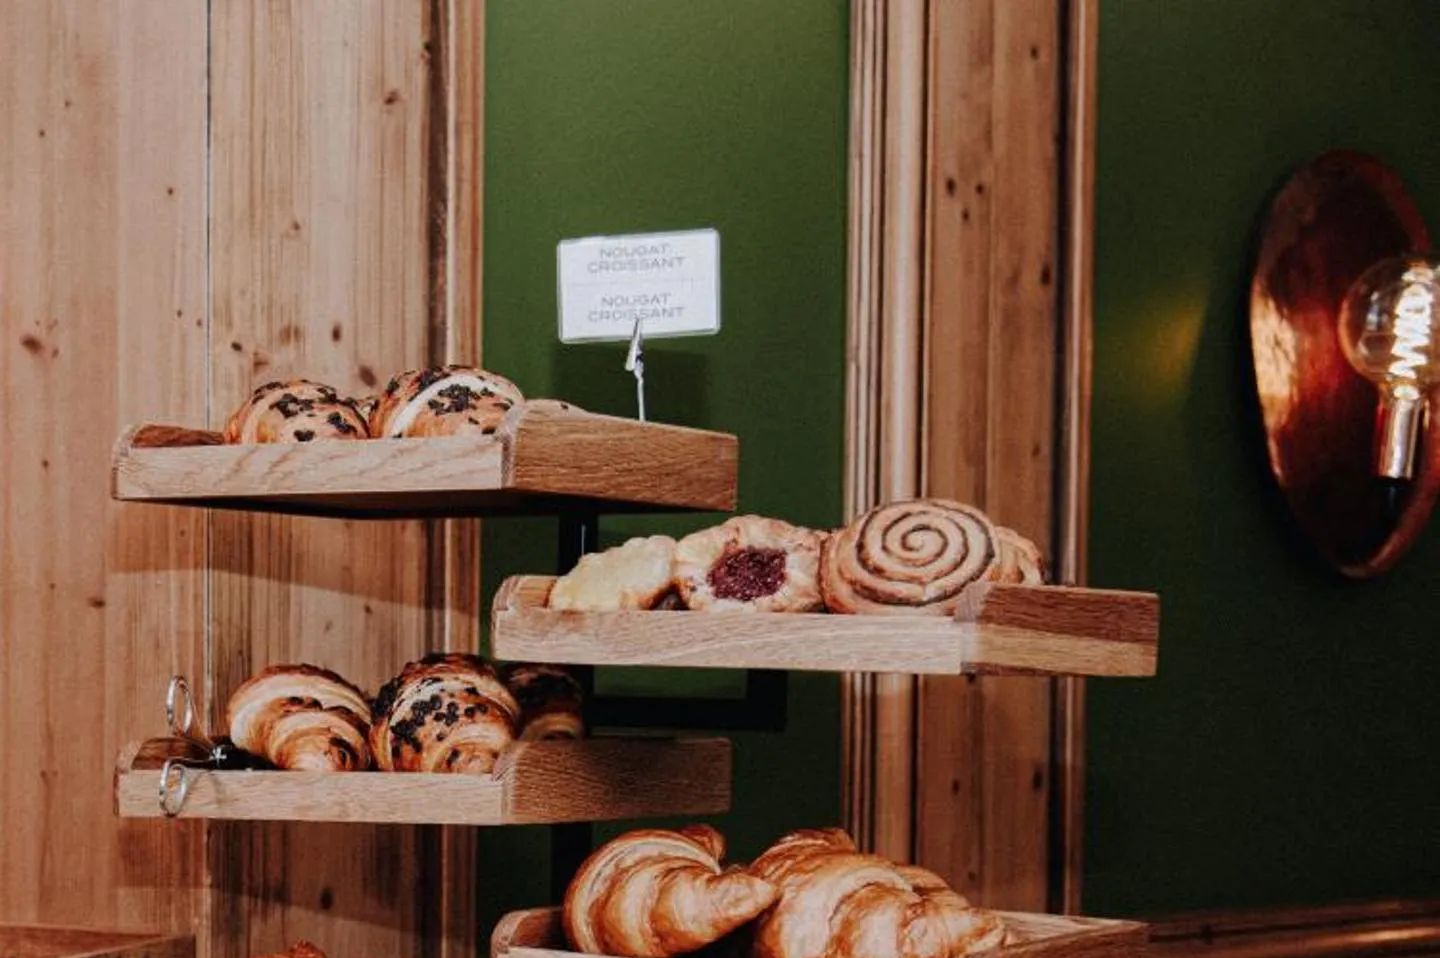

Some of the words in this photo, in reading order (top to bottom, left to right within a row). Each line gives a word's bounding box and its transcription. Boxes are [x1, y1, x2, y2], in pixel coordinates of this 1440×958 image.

[599, 243, 671, 258] NOUGAT
[587, 257, 685, 274] CROISSANT
[601, 293, 671, 307] NOUGAT
[588, 306, 685, 323] CROISSANT
